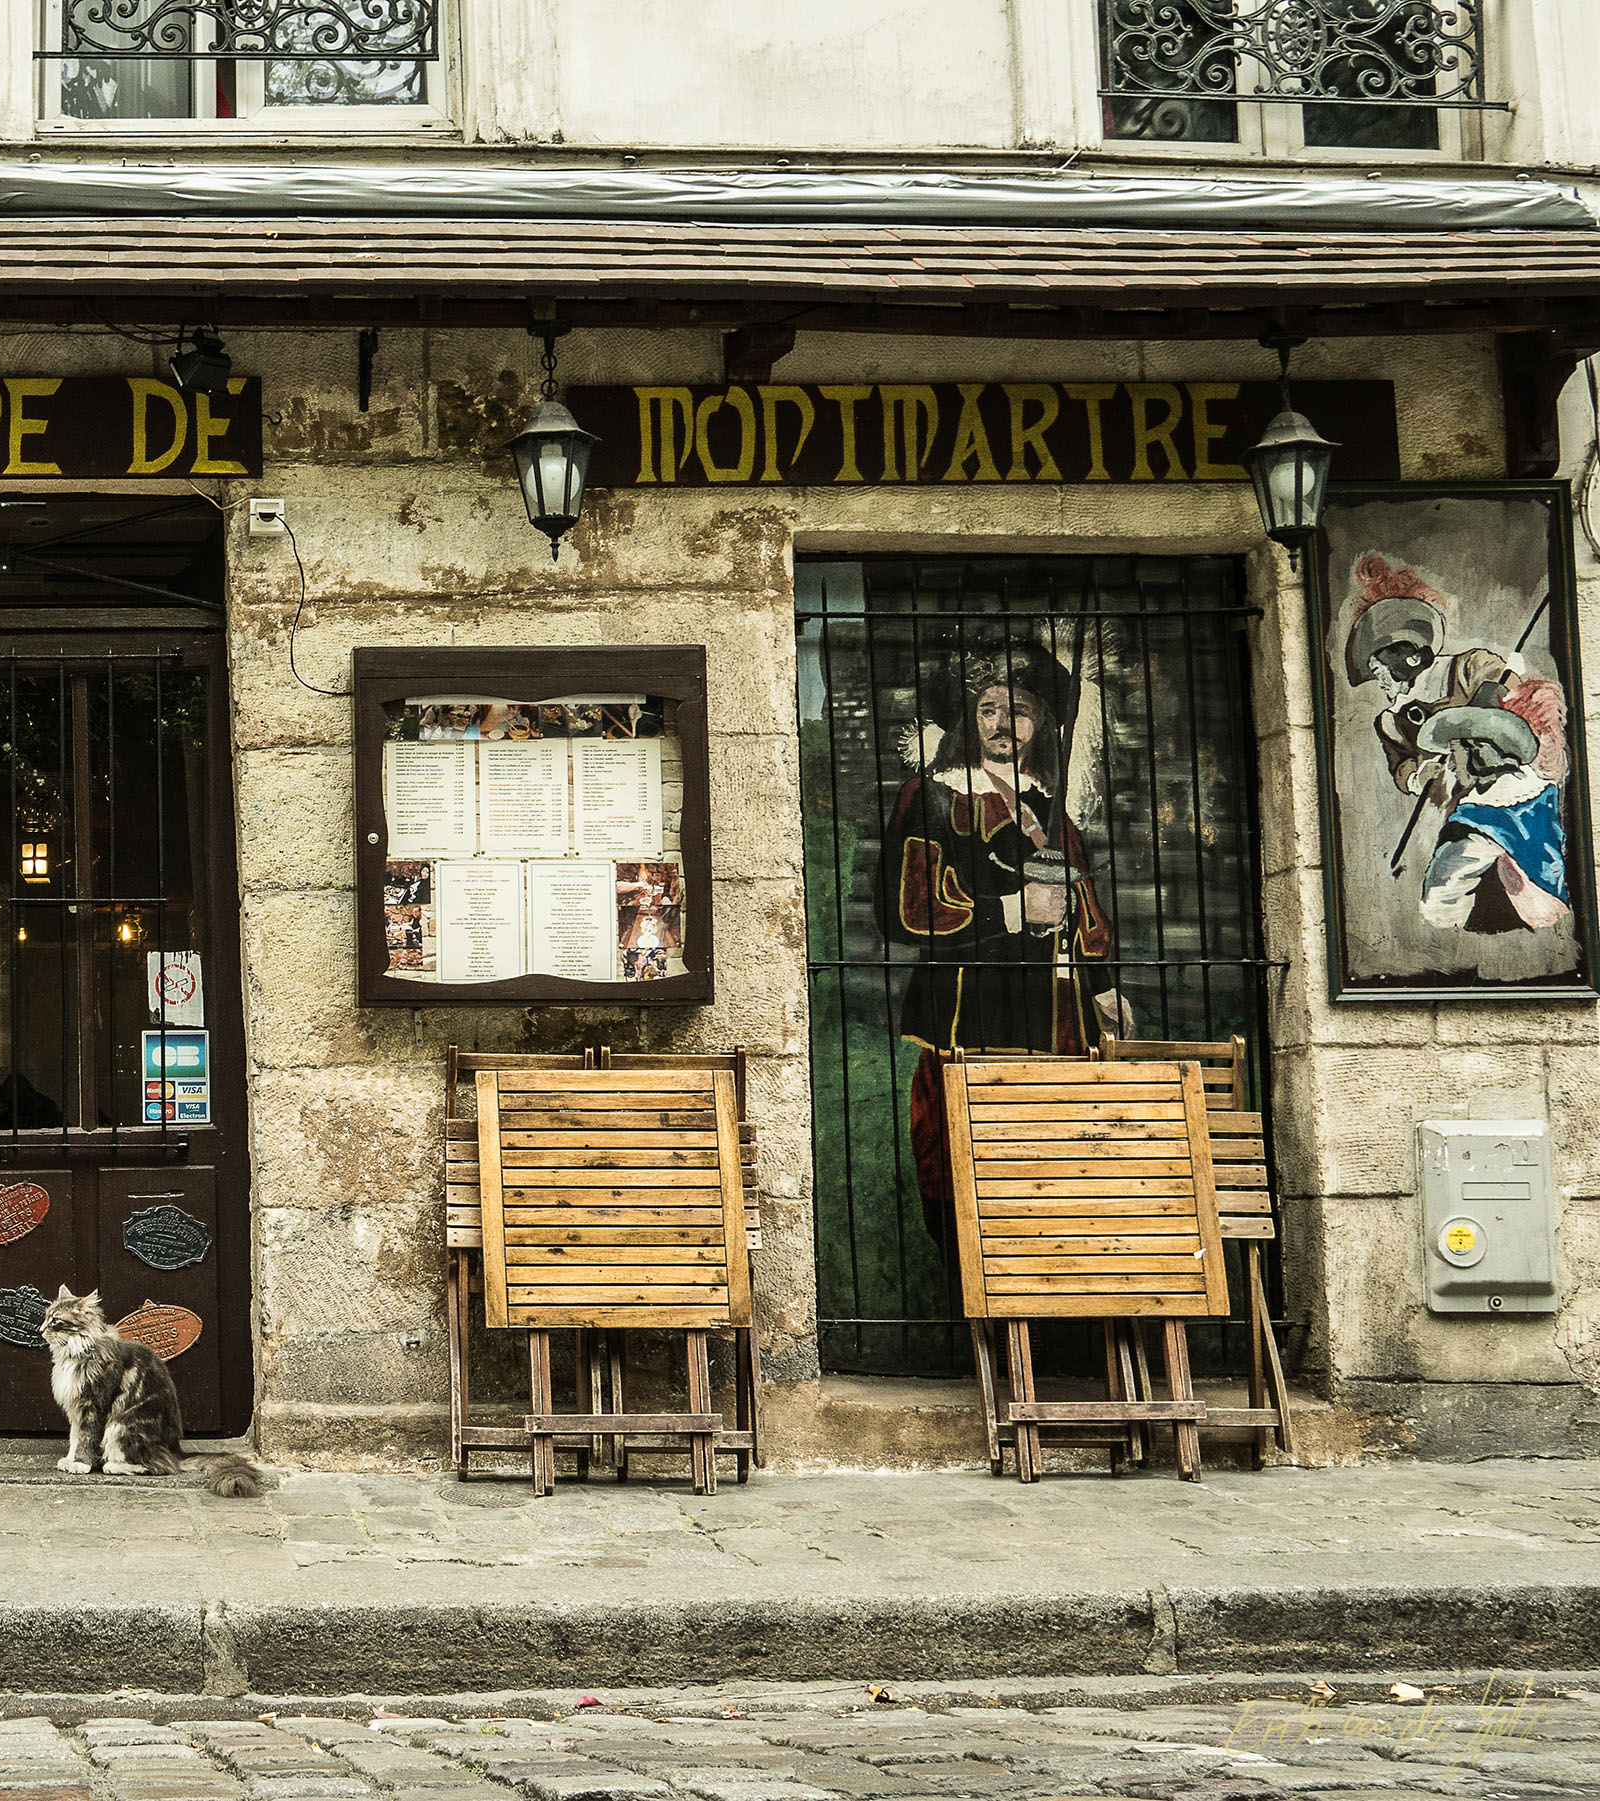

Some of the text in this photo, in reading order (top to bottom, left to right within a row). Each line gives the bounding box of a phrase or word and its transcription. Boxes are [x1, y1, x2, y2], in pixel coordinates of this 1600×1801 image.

[126, 377, 250, 474] DE
[633, 383, 1250, 484] MONTMARTRE
[182, 1086, 203, 1094] VISA
